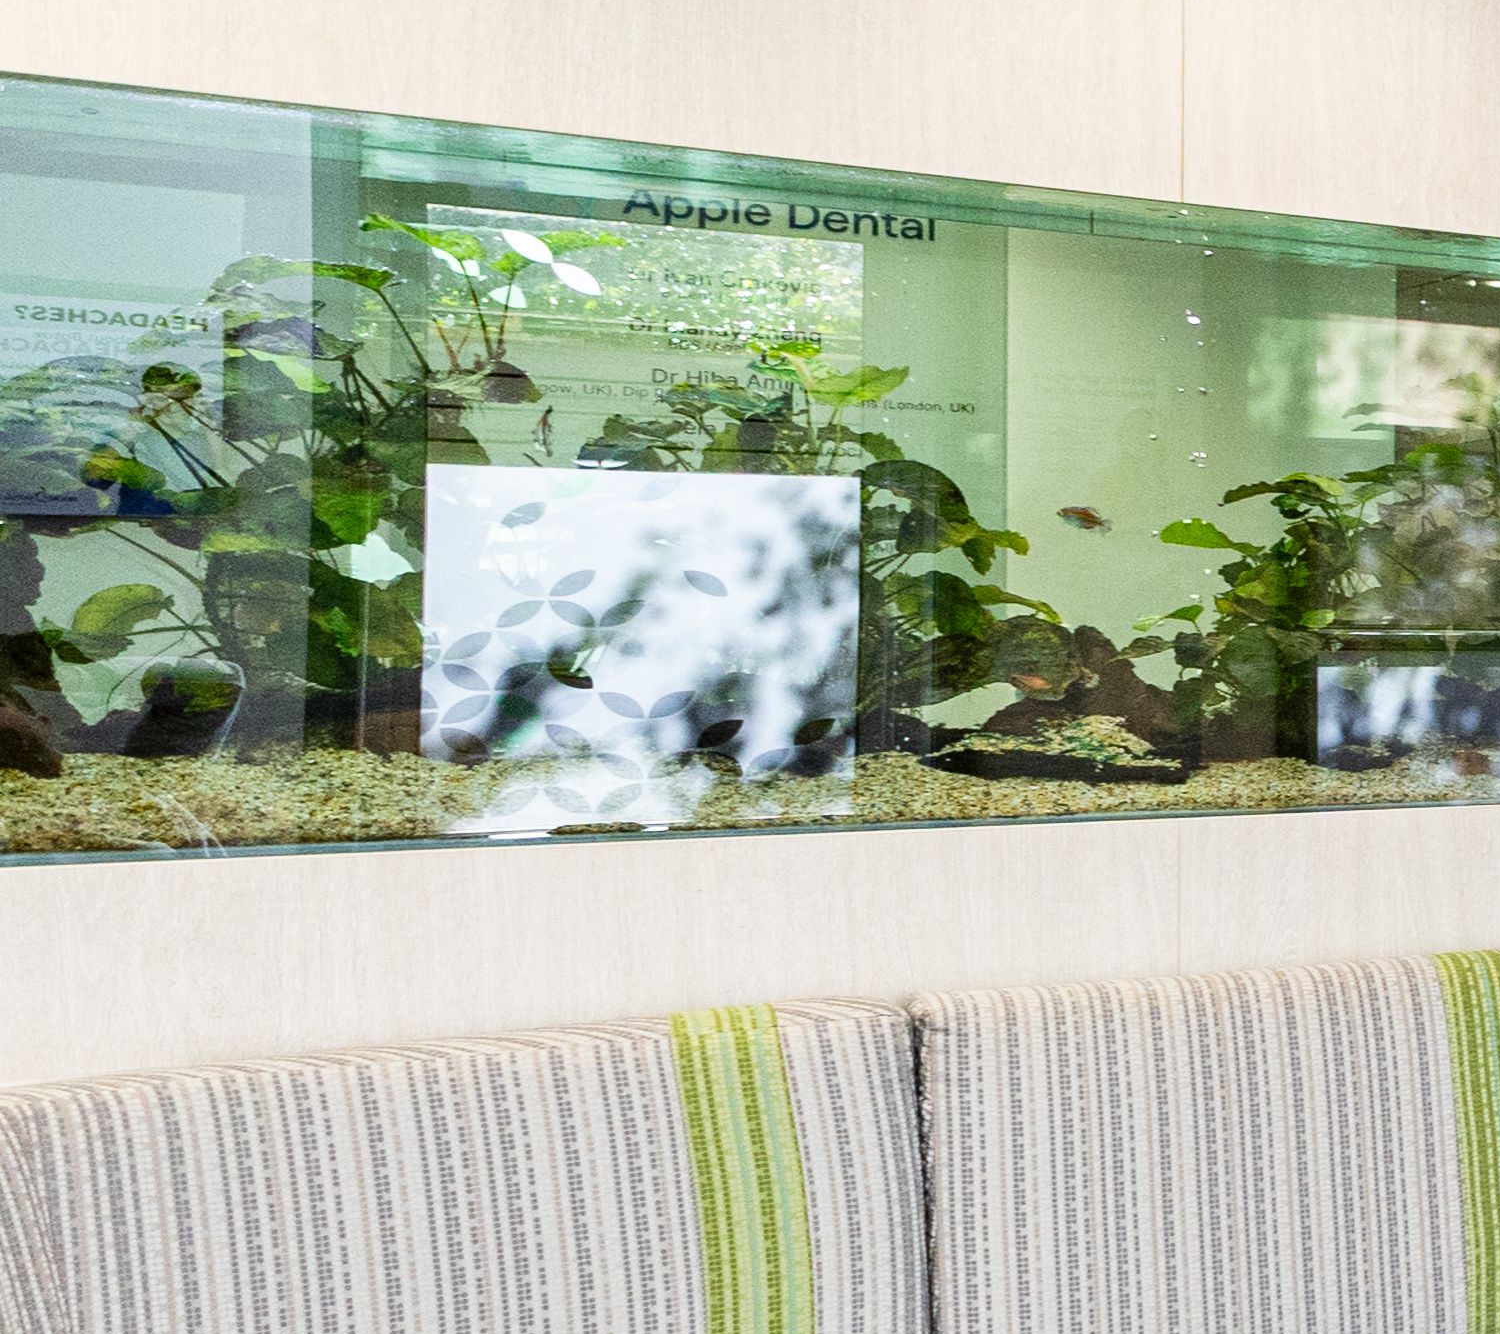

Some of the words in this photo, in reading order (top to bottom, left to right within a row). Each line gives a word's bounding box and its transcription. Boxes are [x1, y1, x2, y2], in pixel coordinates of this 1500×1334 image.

[622, 189, 772, 230] Apple
[788, 205, 936, 242] Dental
[652, 368, 671, 385] Dr
